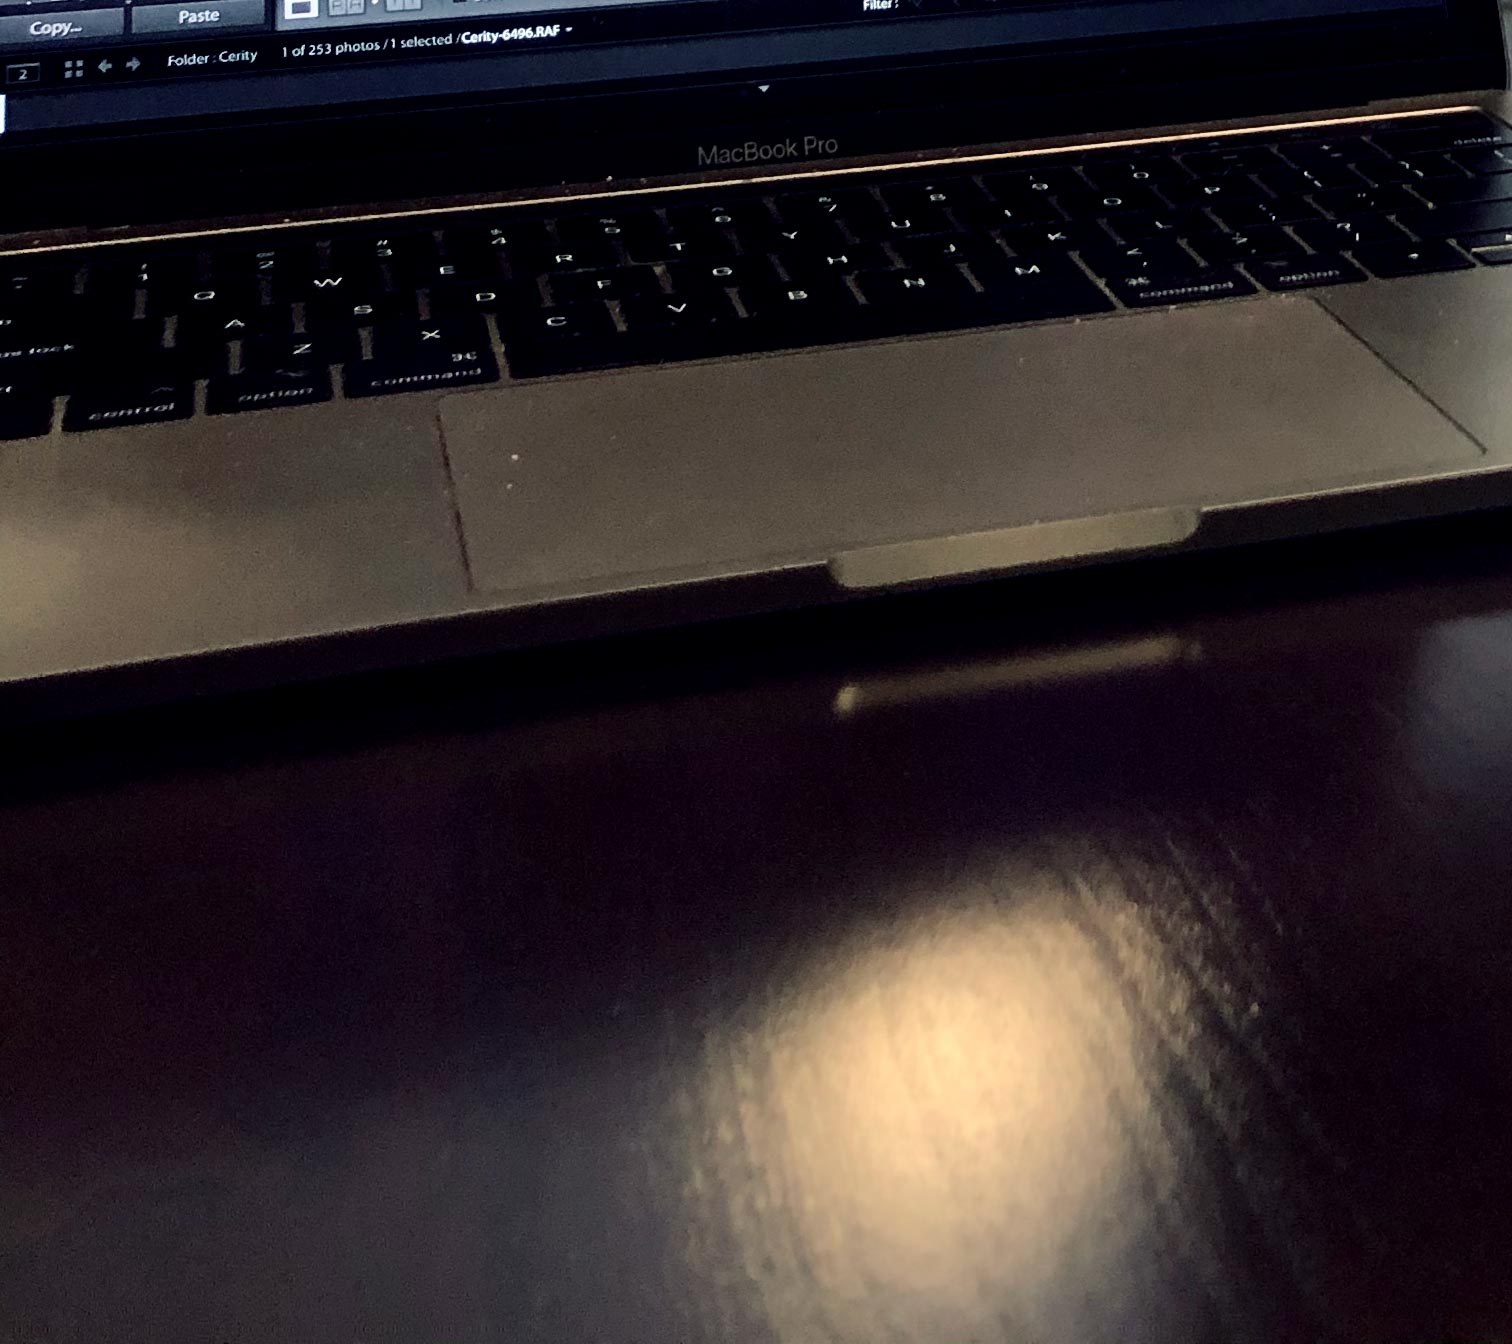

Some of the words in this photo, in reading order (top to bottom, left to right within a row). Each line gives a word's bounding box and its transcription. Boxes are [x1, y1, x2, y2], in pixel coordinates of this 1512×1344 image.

[178, 9, 220, 24] Paste
[19, 69, 28, 80] 2
[218, 50, 258, 64] Cerity
[292, 44, 306, 57] of
[308, 44, 332, 56] 253
[335, 40, 381, 57] photos
[401, 34, 453, 49] selected
[698, 138, 799, 166] MacBook
[804, 135, 839, 156] Pro
